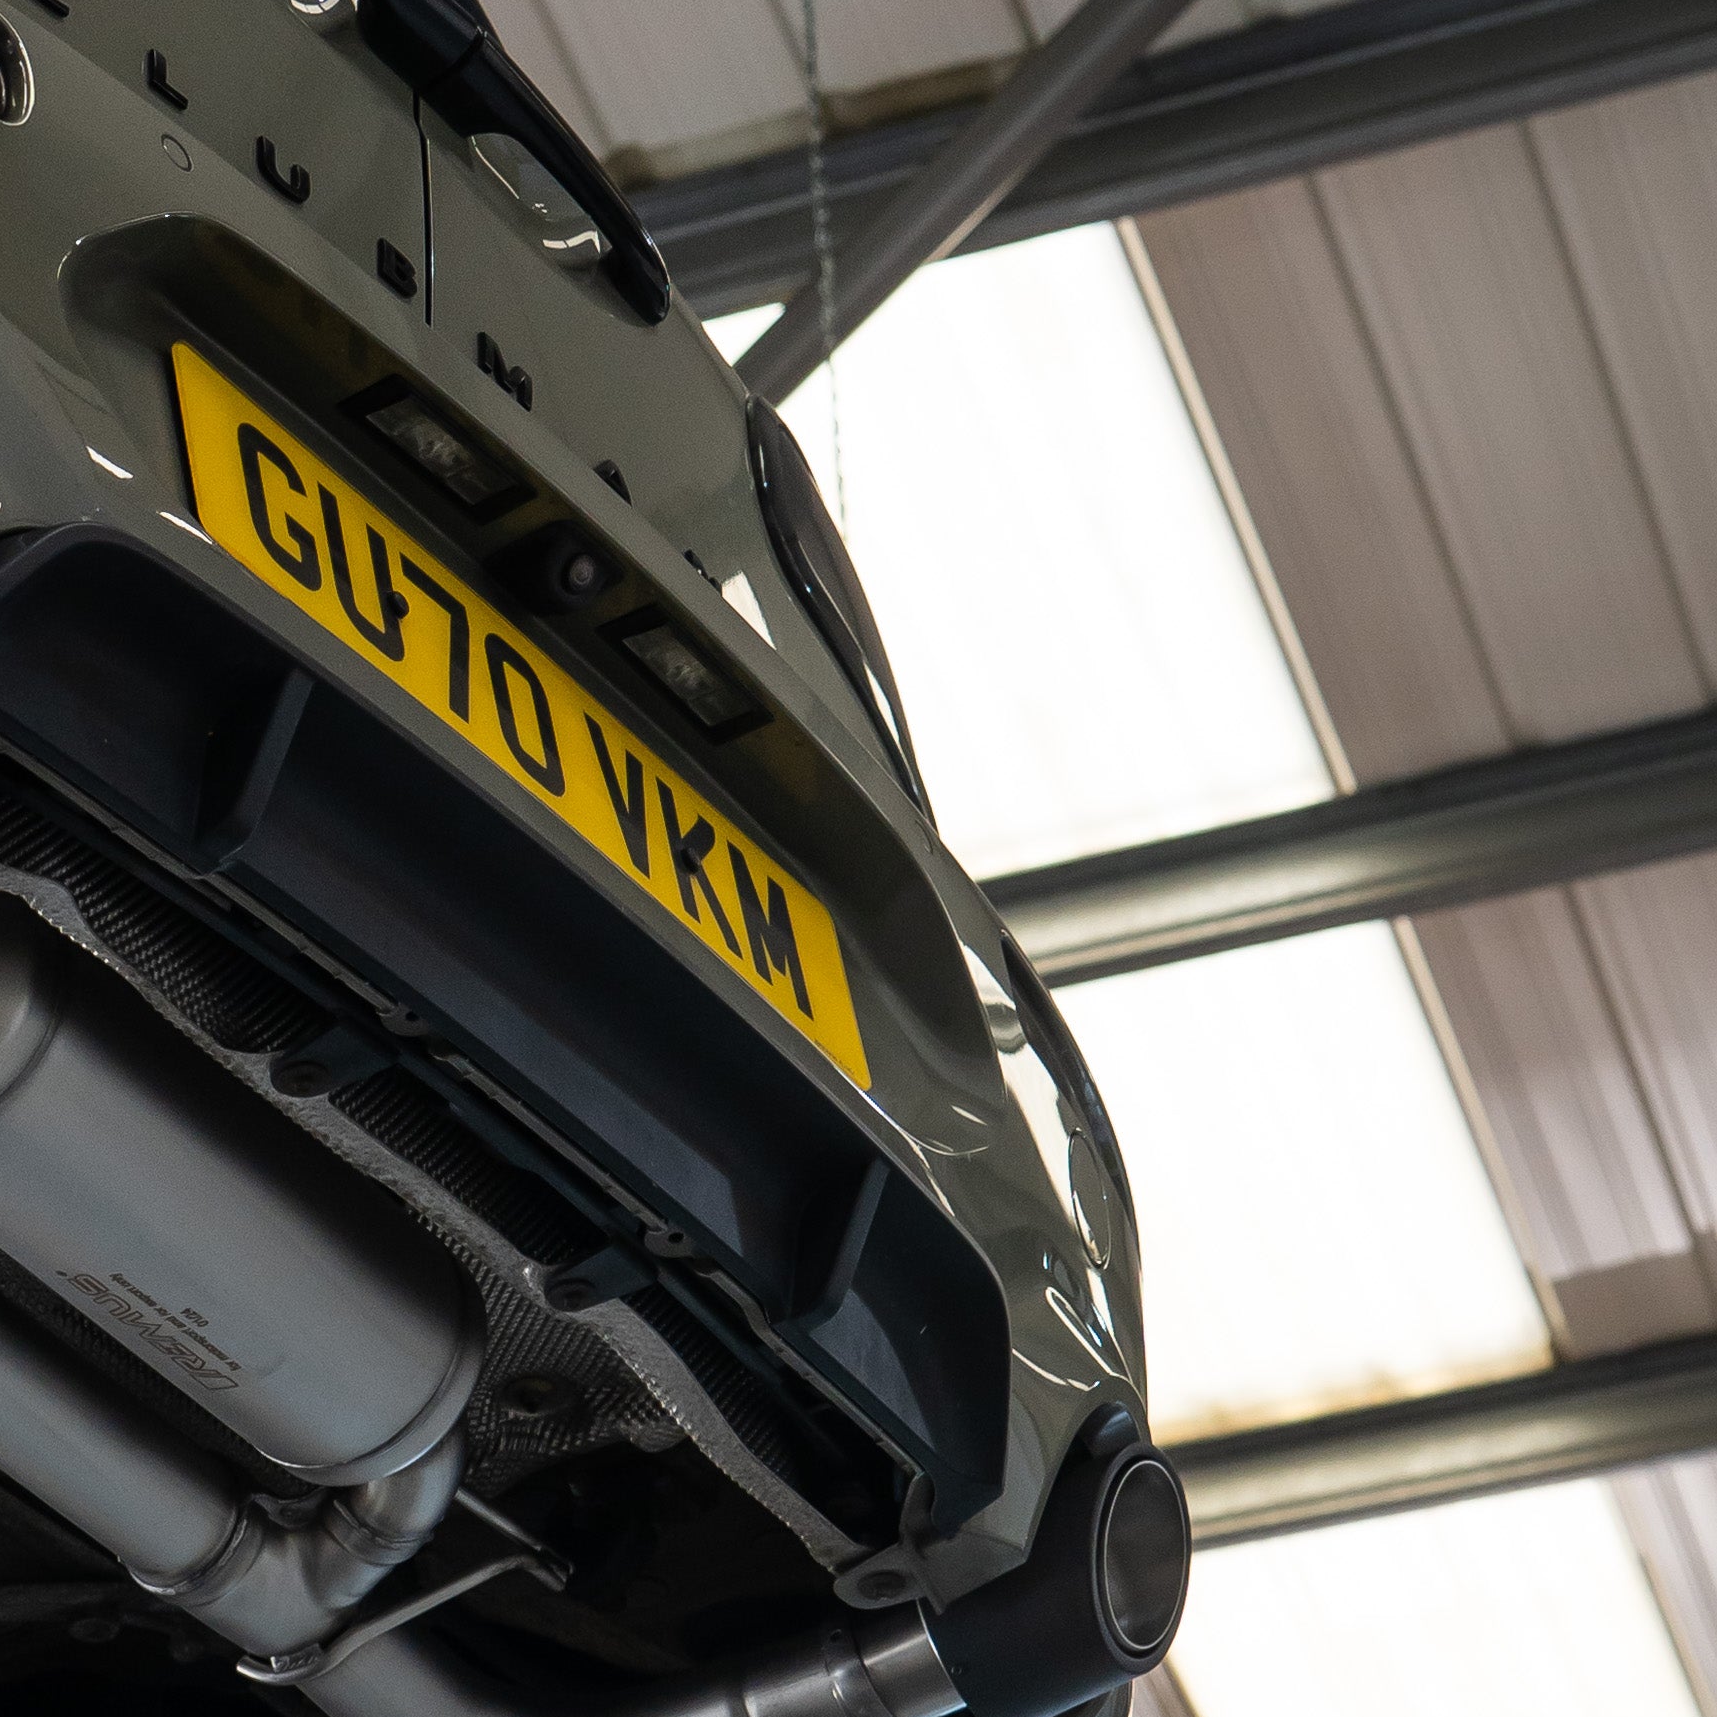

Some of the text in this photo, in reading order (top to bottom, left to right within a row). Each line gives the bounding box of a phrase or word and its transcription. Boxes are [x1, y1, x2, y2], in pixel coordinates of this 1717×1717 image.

[237, 421, 815, 1022] GU70 VKM
[68, 1273, 239, 1390] REMUS
